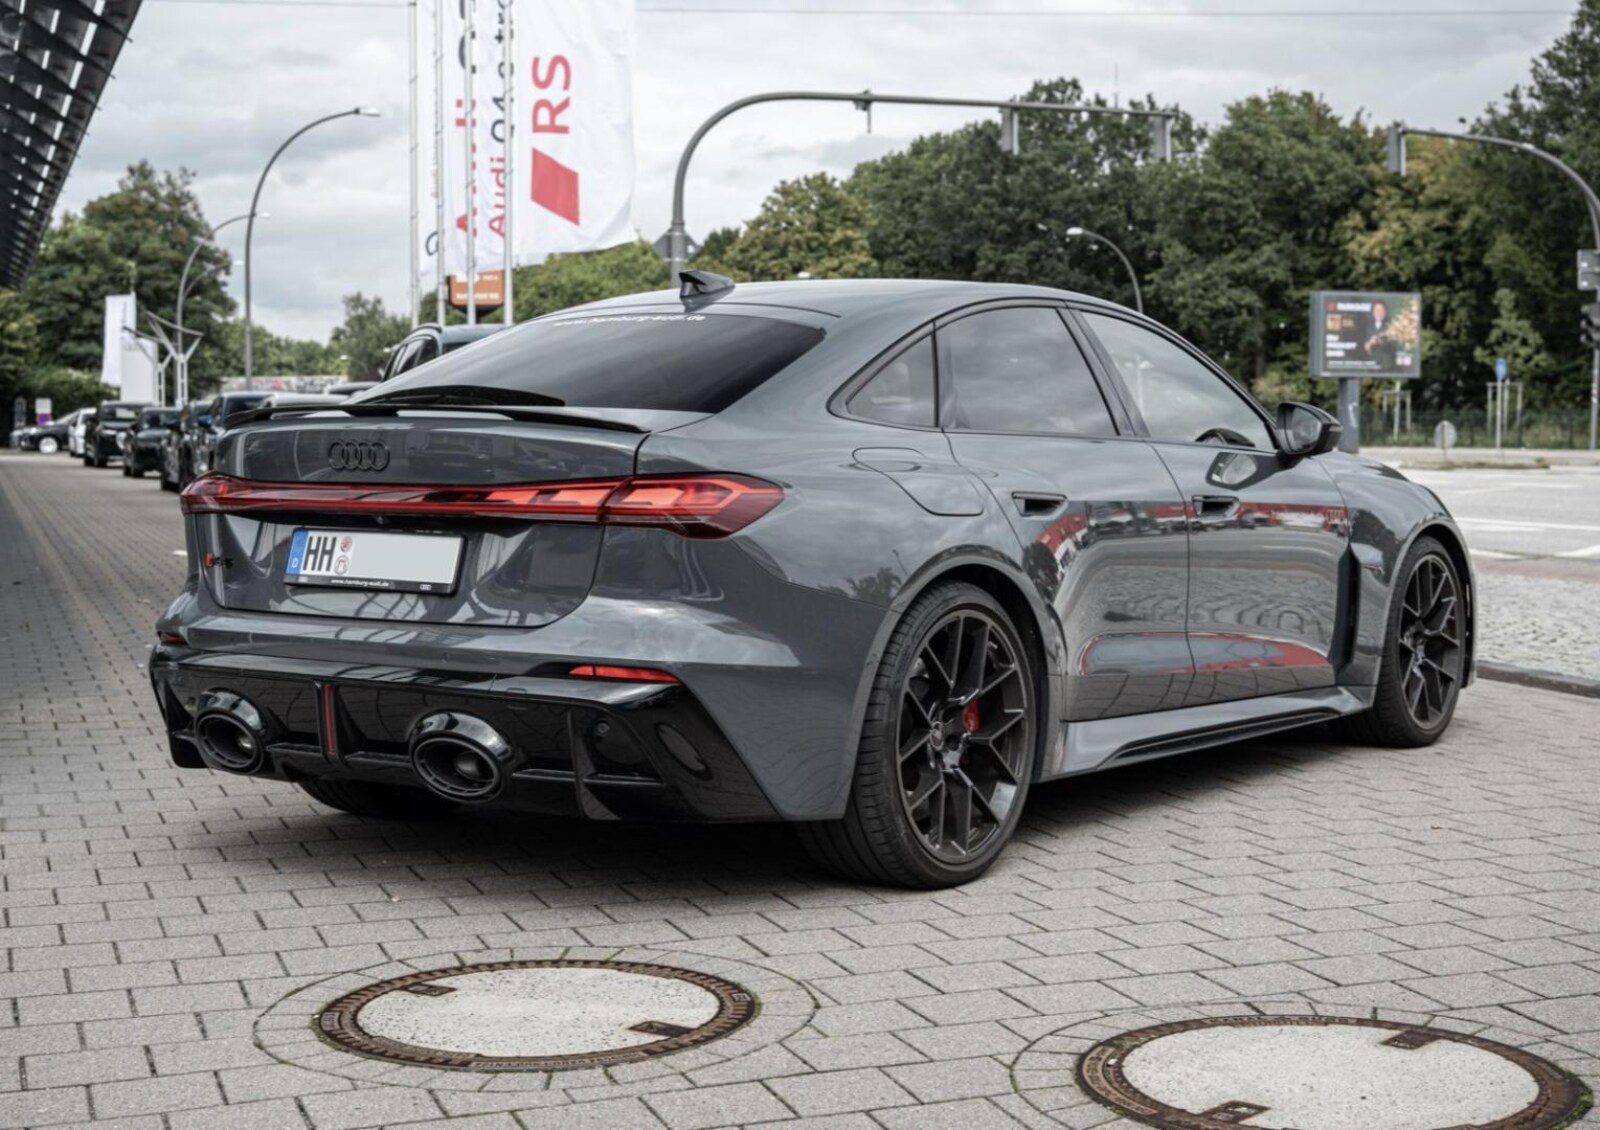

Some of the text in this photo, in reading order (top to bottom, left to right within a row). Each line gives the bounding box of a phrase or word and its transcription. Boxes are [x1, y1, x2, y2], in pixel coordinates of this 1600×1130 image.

[494, 0, 514, 78] etr
[531, 54, 571, 133] RS
[491, 96, 515, 143] Q4
[291, 558, 298, 568] D
[303, 537, 336, 571] HH
